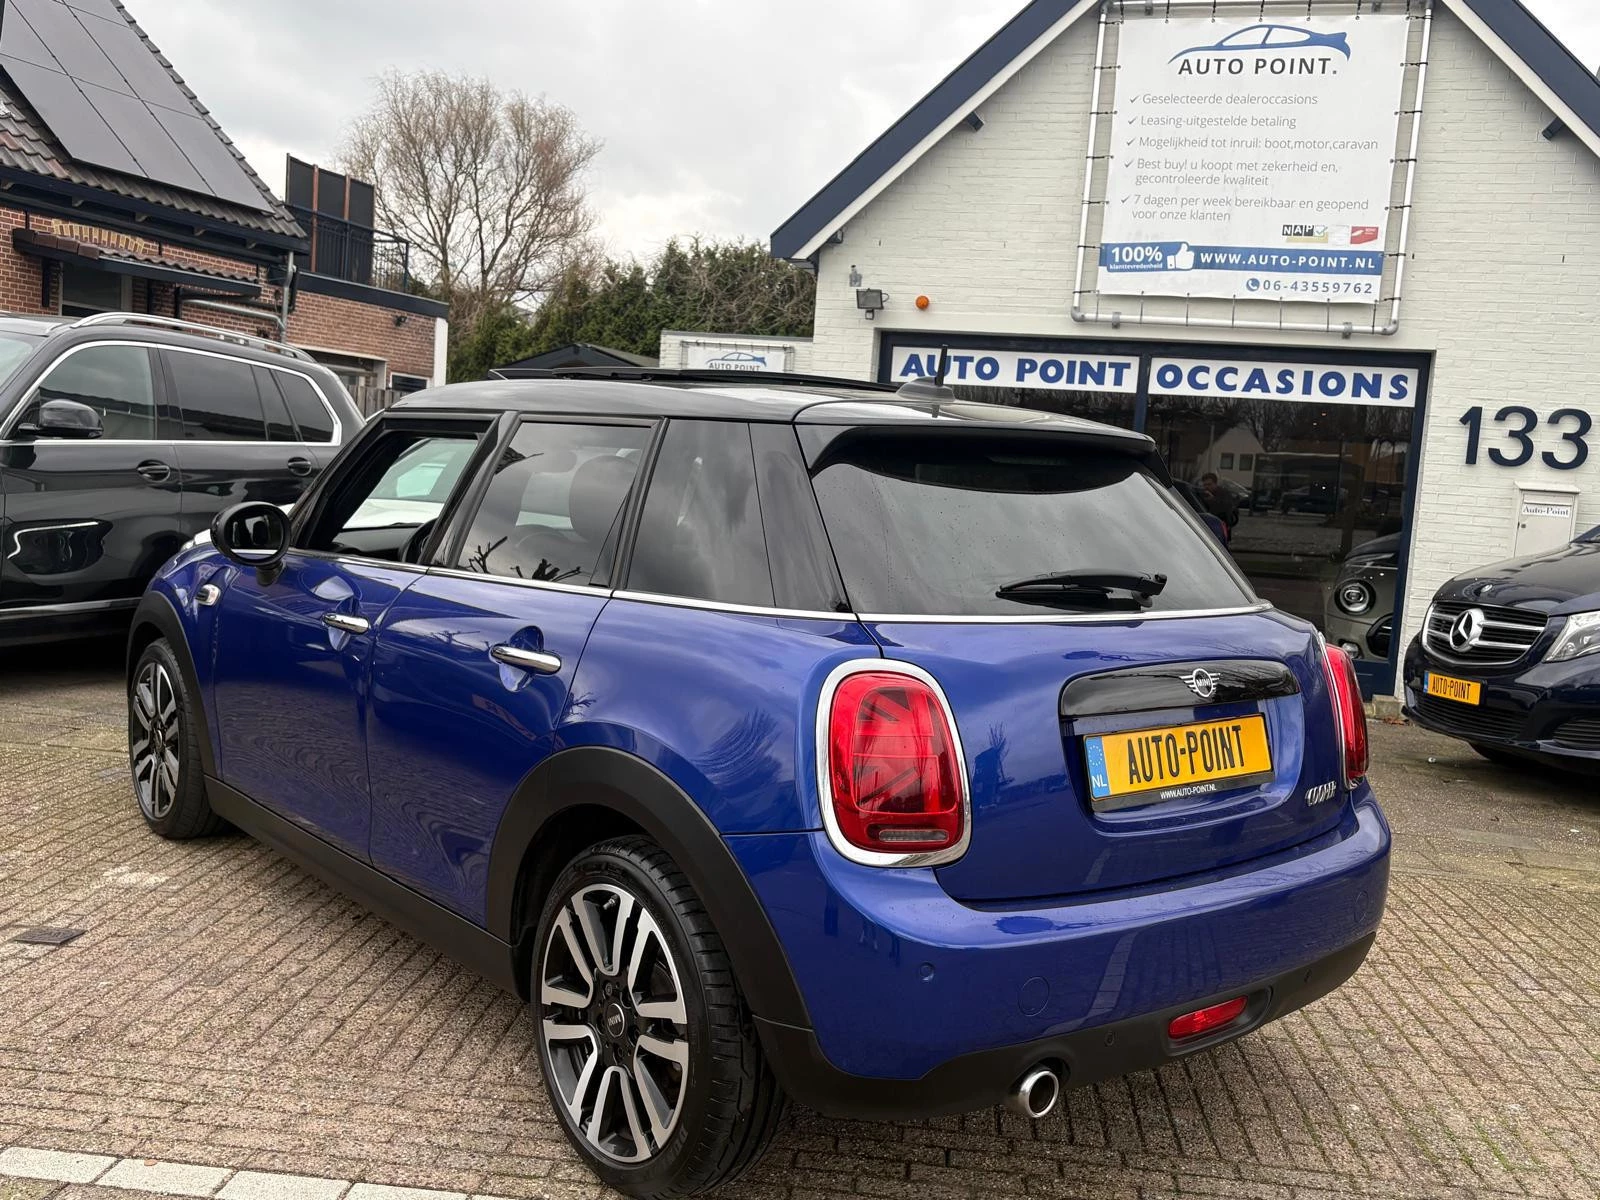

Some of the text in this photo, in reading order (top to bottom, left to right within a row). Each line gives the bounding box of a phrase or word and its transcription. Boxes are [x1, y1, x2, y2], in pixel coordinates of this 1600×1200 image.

[1178, 58, 1243, 75] AUTO
[1142, 93, 1318, 105] Geselecteerde dealeroccasions
[1141, 115, 1296, 129] Leasing-uitgestelde betaling
[1139, 136, 1379, 150] Mogelijkheid tot inruil: boot,motor,caravan
[1137, 158, 1161, 170] Best
[1164, 158, 1187, 172] buy!
[1190, 159, 1198, 170] u
[1201, 159, 1233, 173] koopt
[1236, 161, 1258, 171] met
[1261, 160, 1318, 172] zekerheid
[1135, 173, 1269, 186] gecontroleerde kwaliteit
[1134, 194, 1369, 212] 7 dagen per week bereikbaar en geopend
[1132, 209, 1231, 221] voor onze klanten
[1282, 224, 1314, 237] NAP
[1111, 246, 1375, 269] 100% WWW.AUTO-POINT.NL
[1263, 279, 1373, 294] 06-43559762
[709, 362, 732, 371] AUTO
[900, 353, 1409, 400] AUTO POINT OCCASIONS
[1459, 405, 1592, 470] 133
[1523, 505, 1569, 516] Auto-Point
[1196, 678, 1211, 687] MINI
[1128, 724, 1245, 785] AUTO-POINT
[1092, 774, 1107, 788] NL
[1159, 783, 1217, 799] WWW.AUTO-POINT.NL
